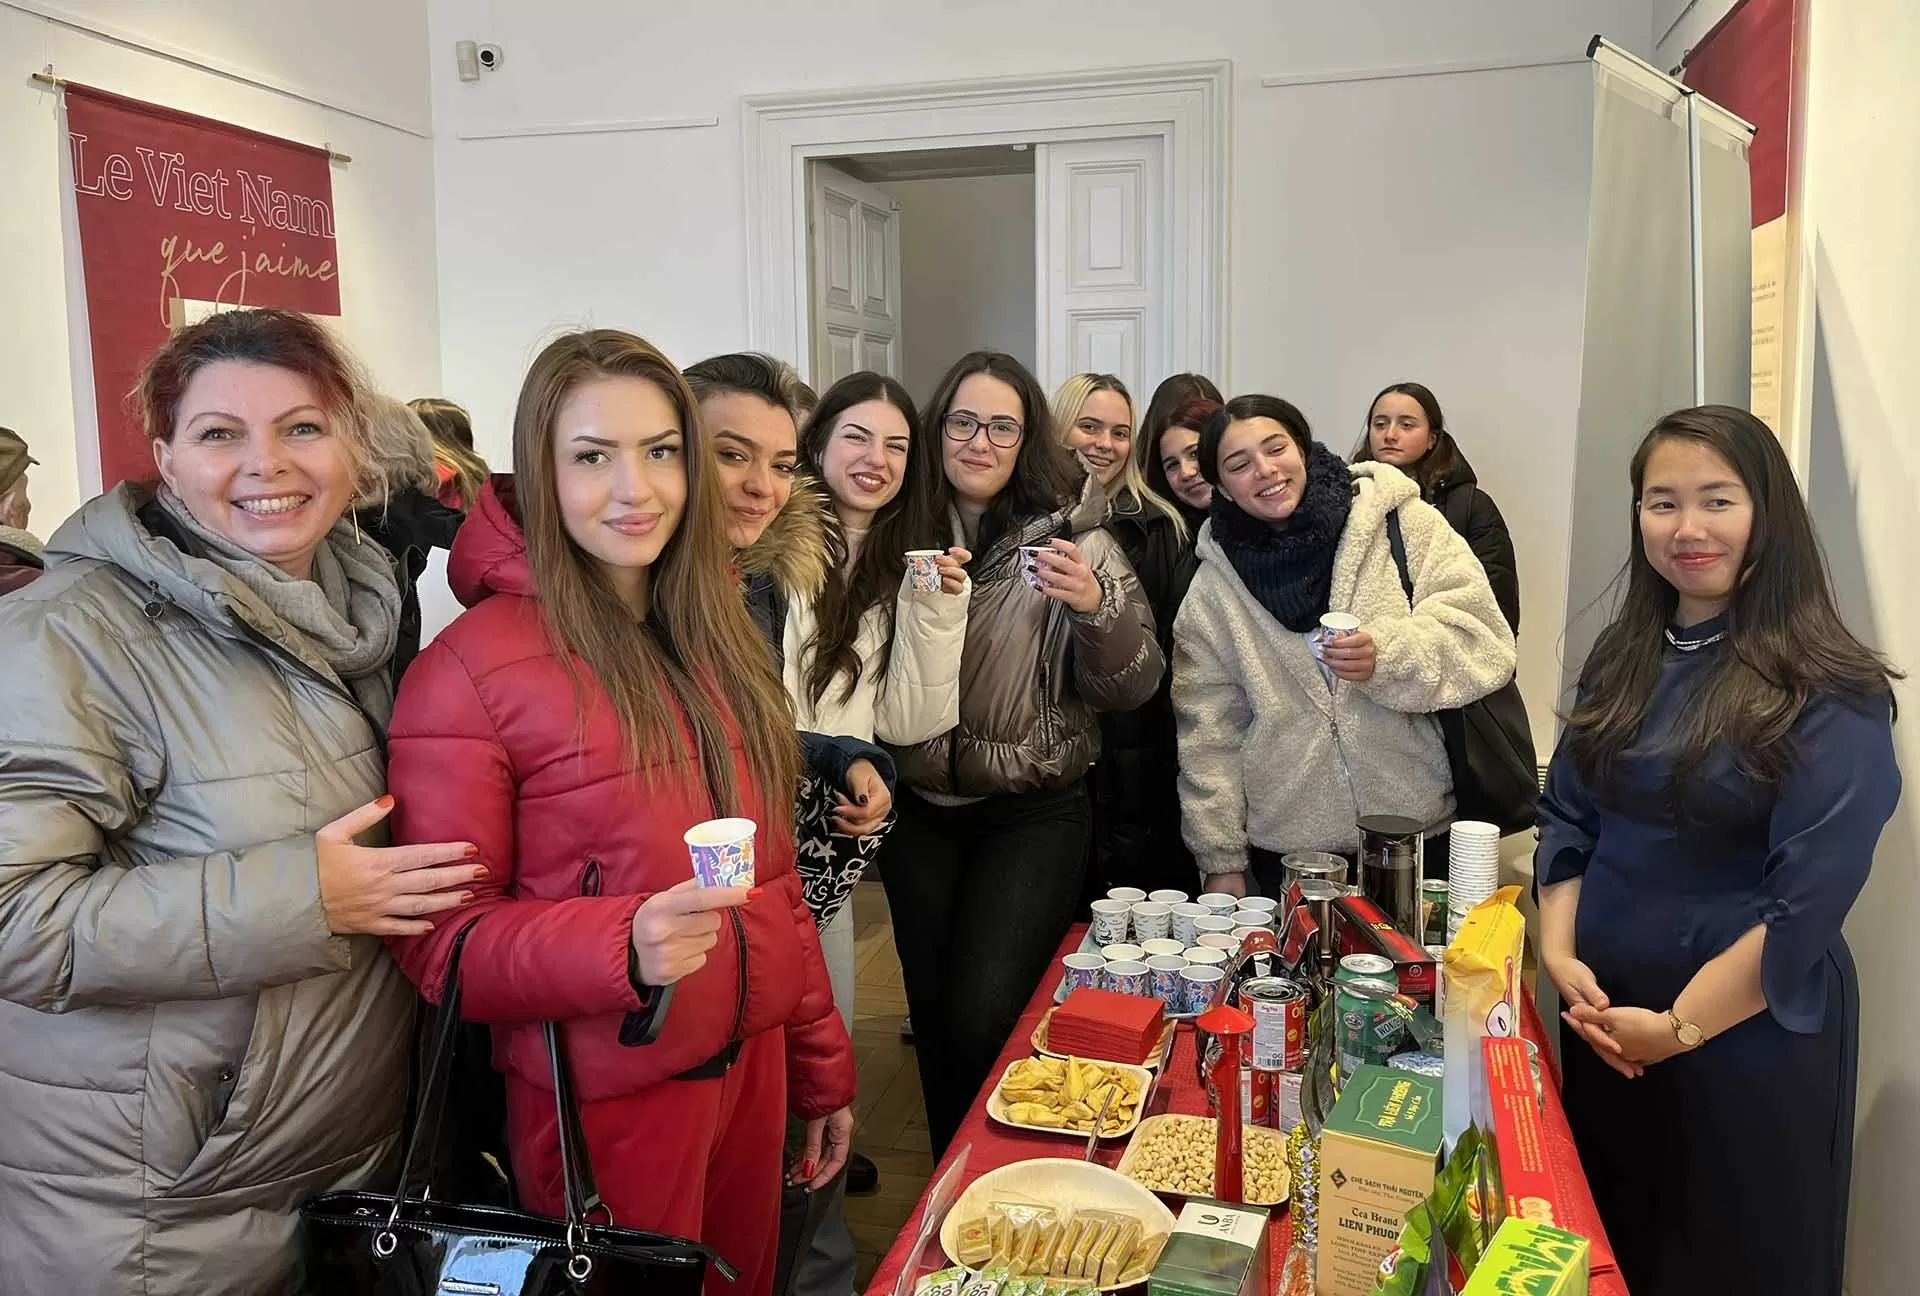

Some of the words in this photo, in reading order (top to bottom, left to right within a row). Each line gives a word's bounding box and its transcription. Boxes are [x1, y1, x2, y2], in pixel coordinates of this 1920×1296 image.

[68, 132, 133, 201] Le
[135, 147, 231, 220] Viet
[236, 169, 336, 239] Nam
[160, 235, 228, 329] que
[215, 226, 338, 313] j'aime
[1338, 1217, 1364, 1232] LIEN
[1366, 1224, 1400, 1241] PHUON
[1351, 1206, 1368, 1221] Tea
[1371, 1211, 1398, 1227] Brand
